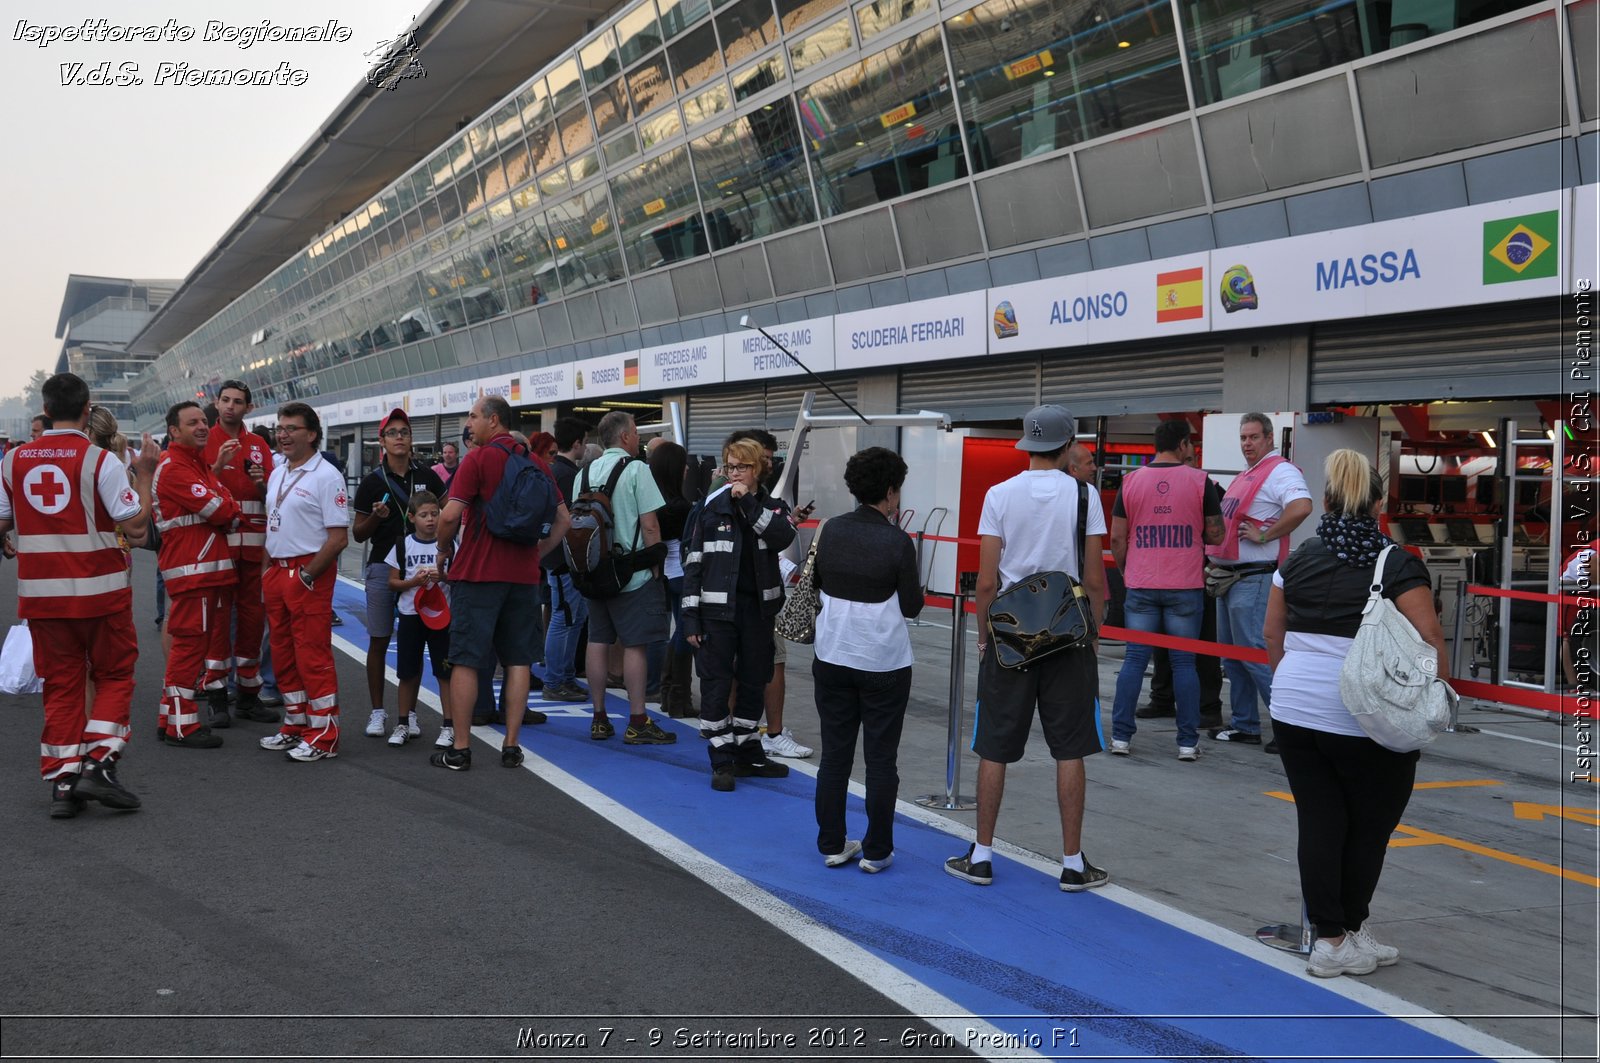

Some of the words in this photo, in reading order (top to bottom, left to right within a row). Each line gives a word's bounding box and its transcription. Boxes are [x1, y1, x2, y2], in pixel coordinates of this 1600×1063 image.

[1316, 248, 1421, 292] MASSA
[1050, 290, 1128, 326] ALONSO
[742, 332, 789, 354] MERCEDES
[790, 328, 812, 346] AMG
[851, 325, 908, 350] SCUDERIA
[911, 317, 965, 343] FERRARI
[653, 349, 690, 367] MERCEDES
[691, 345, 707, 361] AMG
[753, 350, 799, 371] PETRONAS
[529, 371, 553, 386] MERCEDES
[553, 369, 564, 382] AMG
[592, 367, 620, 384] ROSBERG
[662, 365, 698, 382] PETRONAS
[535, 384, 558, 398] PETRONAS
[19, 449, 39, 459] CROCE
[39, 448, 54, 458] ROSSA
[1153, 506, 1172, 514] 0525
[1135, 524, 1193, 549] SERVIZIO
